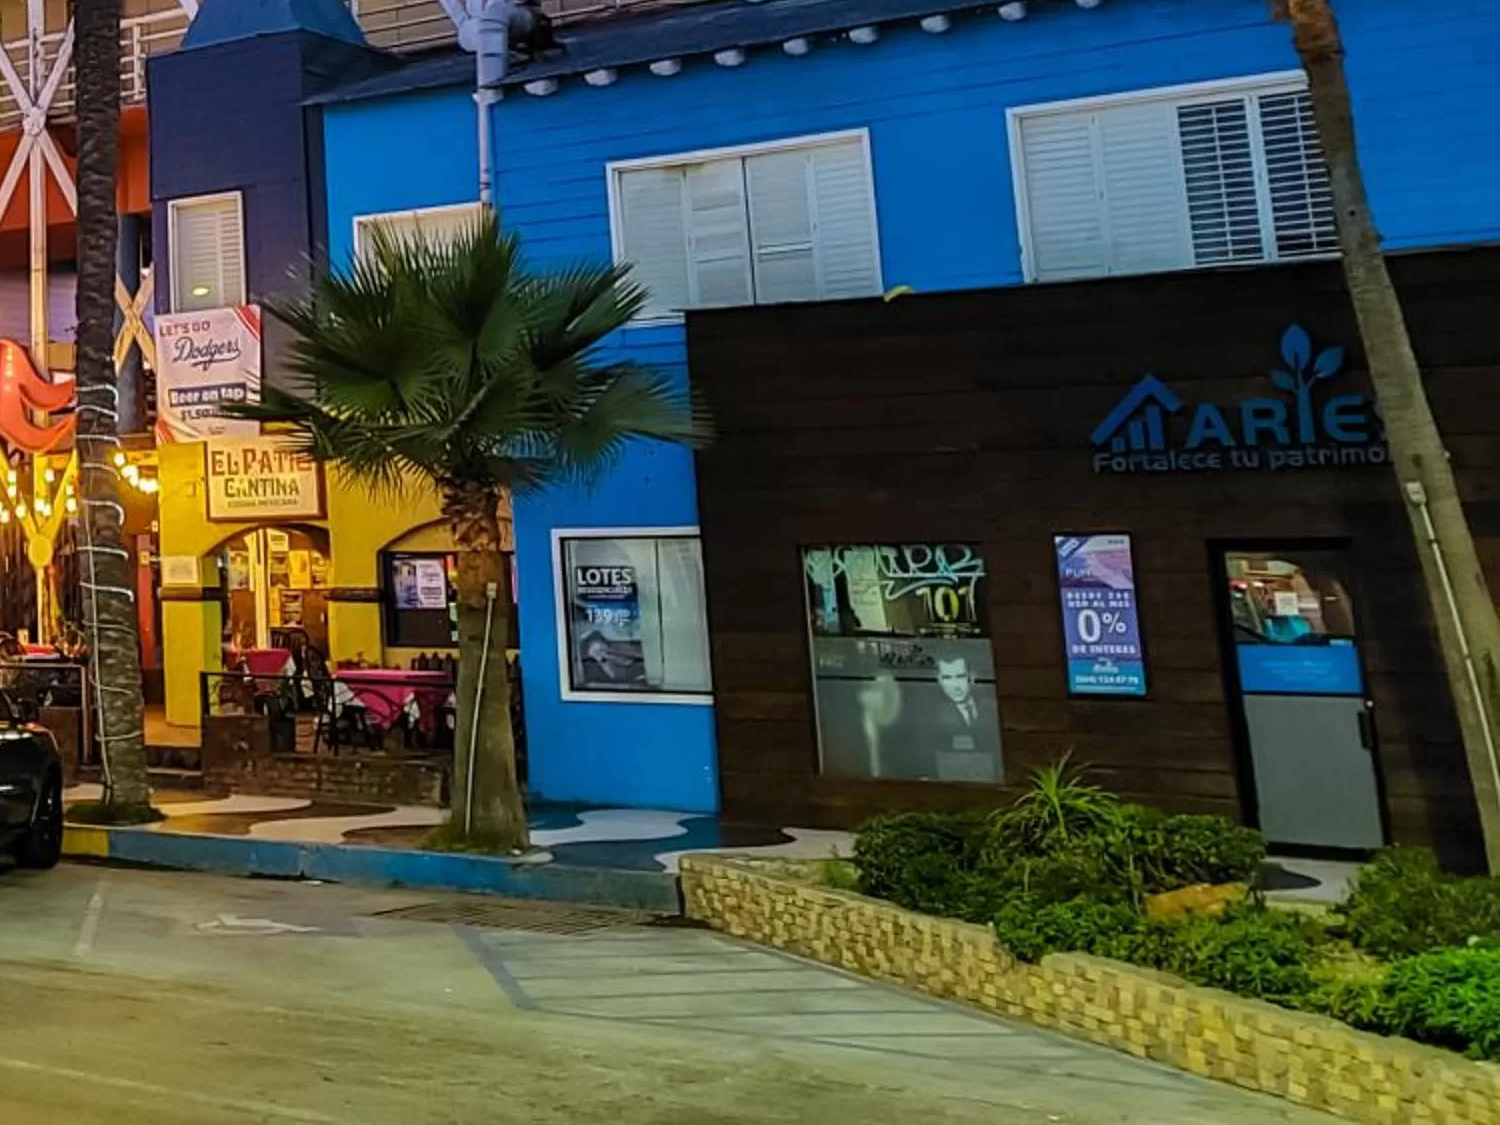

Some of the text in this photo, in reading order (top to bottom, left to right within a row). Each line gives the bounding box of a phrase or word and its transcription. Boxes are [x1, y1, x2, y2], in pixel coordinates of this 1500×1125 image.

[159, 320, 211, 337] LET'S GO
[172, 335, 242, 372] Dodgers
[171, 386, 245, 403] Beer on tap
[211, 450, 240, 476] EL
[1092, 445, 1396, 473] Fortalece tu patrimo
[224, 477, 301, 498] CANTINA
[577, 568, 632, 586] LOTES
[915, 585, 978, 624] 101
[1077, 608, 1128, 644] 0%
